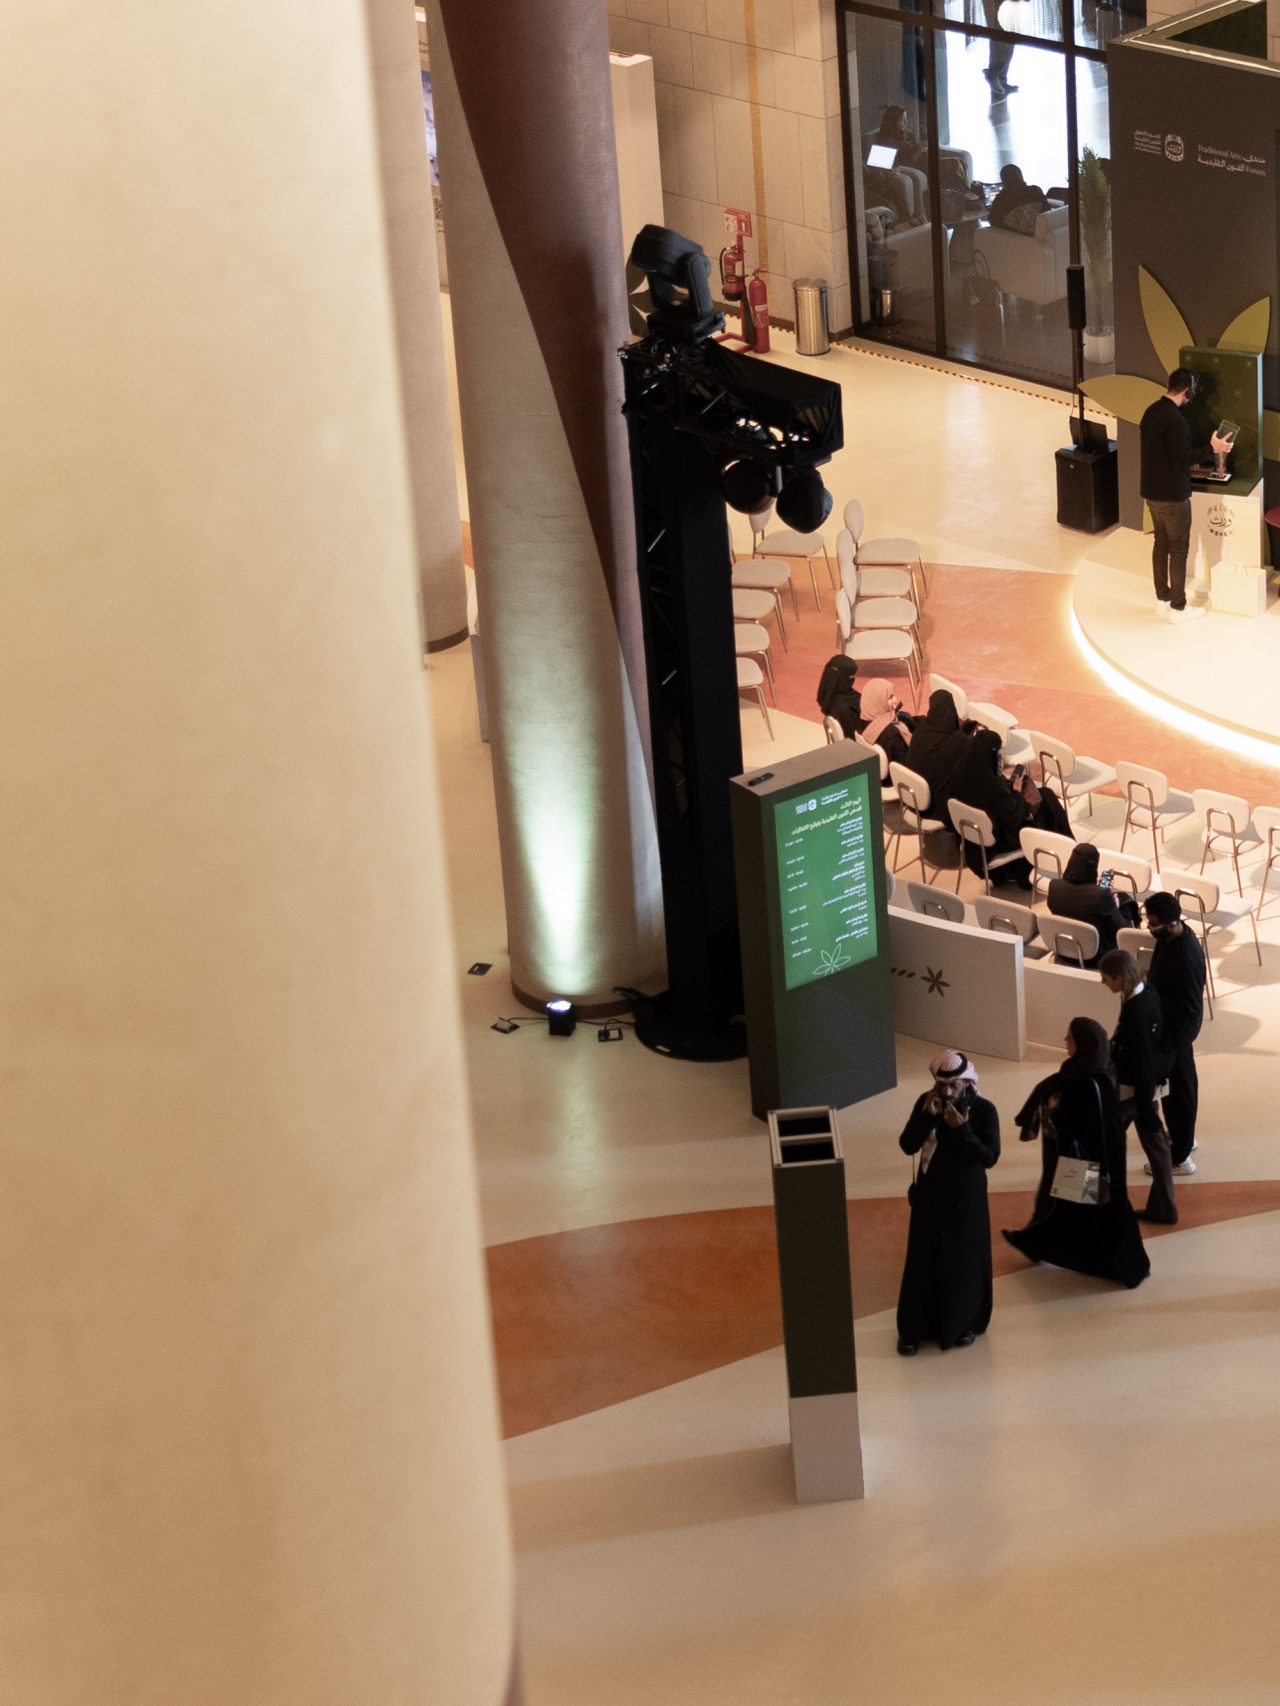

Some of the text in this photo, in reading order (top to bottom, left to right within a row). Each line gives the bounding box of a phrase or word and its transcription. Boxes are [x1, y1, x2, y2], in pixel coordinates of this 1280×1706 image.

[1198, 144, 1242, 161] Traditional Arts
[1242, 153, 1266, 164] منتدى
[1245, 166, 1266, 177] Forum
